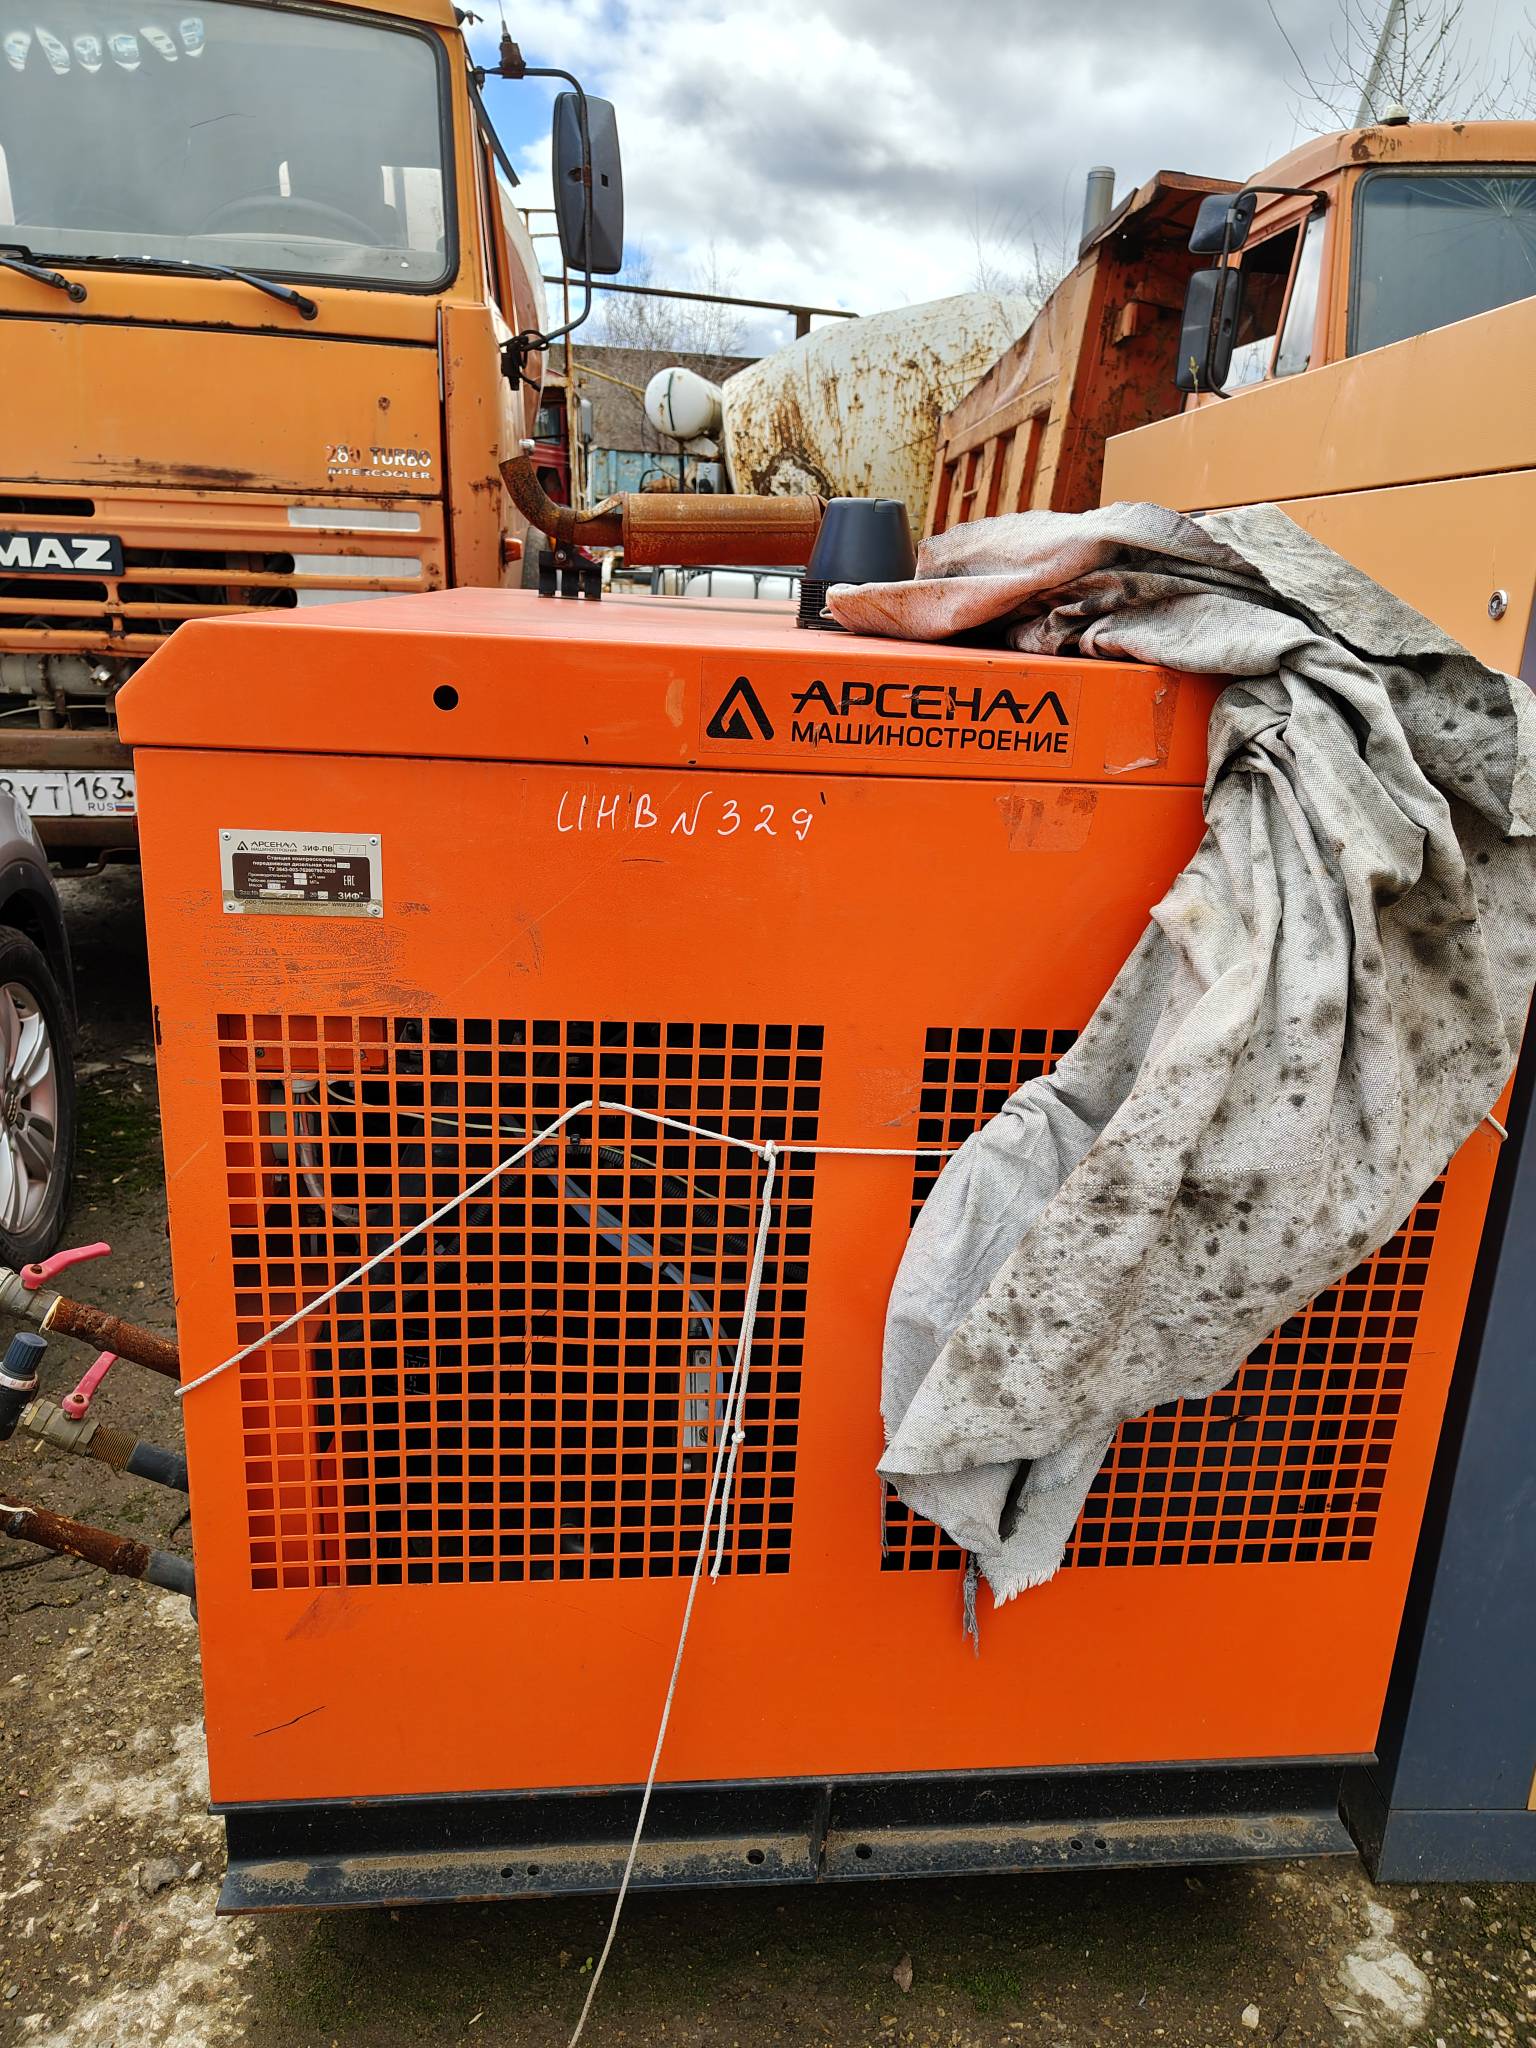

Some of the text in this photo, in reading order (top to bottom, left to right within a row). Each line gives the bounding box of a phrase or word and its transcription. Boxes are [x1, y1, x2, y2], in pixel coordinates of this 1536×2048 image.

[370, 447, 432, 467] TURBO
[327, 467, 431, 479] INTERCOOLER
[790, 680, 1070, 726] АРСЕНАЛ
[790, 721, 1069, 754] МАШИНОСТРОЕНИЕ
[74, 777, 127, 800] 163
[88, 802, 114, 812] RUS
[250, 841, 297, 849] АРСЕНАЛ
[302, 845, 333, 853] ЗИФ-ПВ
[252, 860, 291, 868] передвижная
